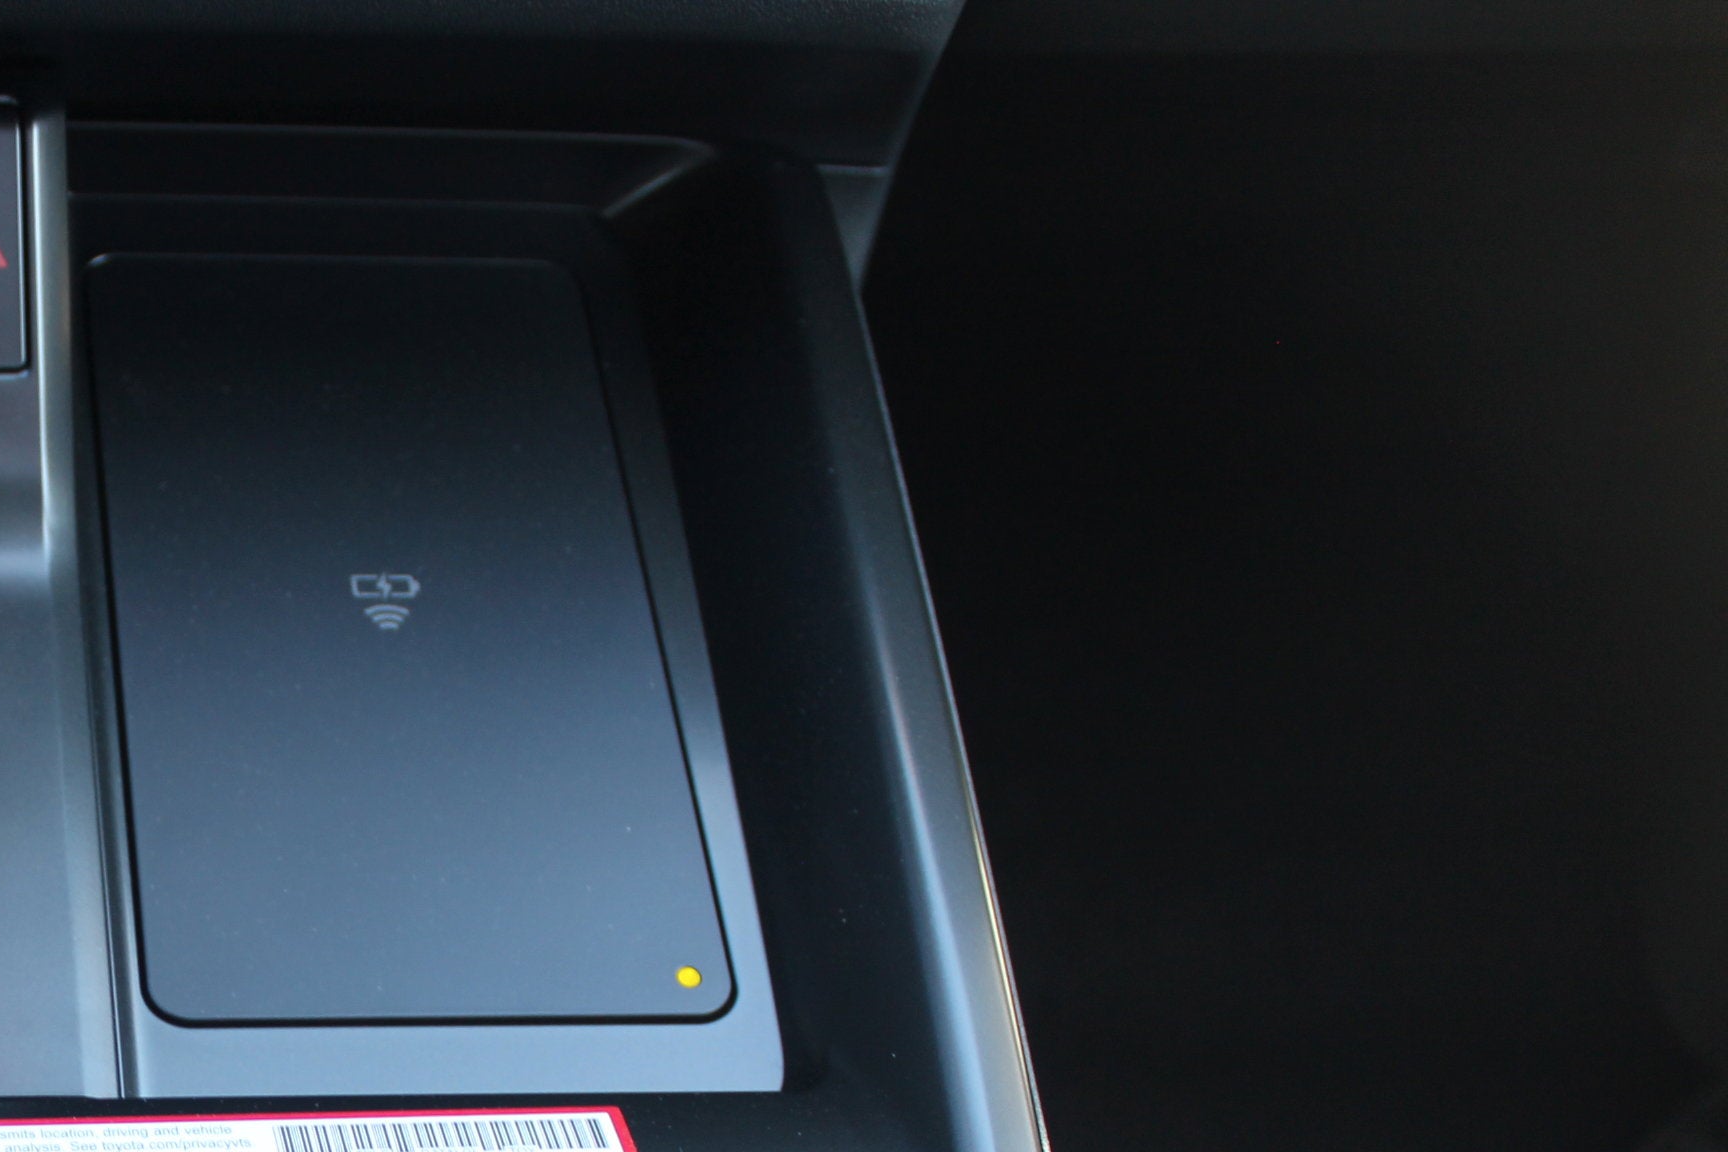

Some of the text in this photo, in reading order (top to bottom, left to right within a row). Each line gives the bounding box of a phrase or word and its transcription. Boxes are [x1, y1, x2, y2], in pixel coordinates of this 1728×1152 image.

[103, 1127, 148, 1139] driving
[154, 1125, 179, 1136] and
[185, 1124, 233, 1135] vehicle
[69, 1140, 98, 1151] See
